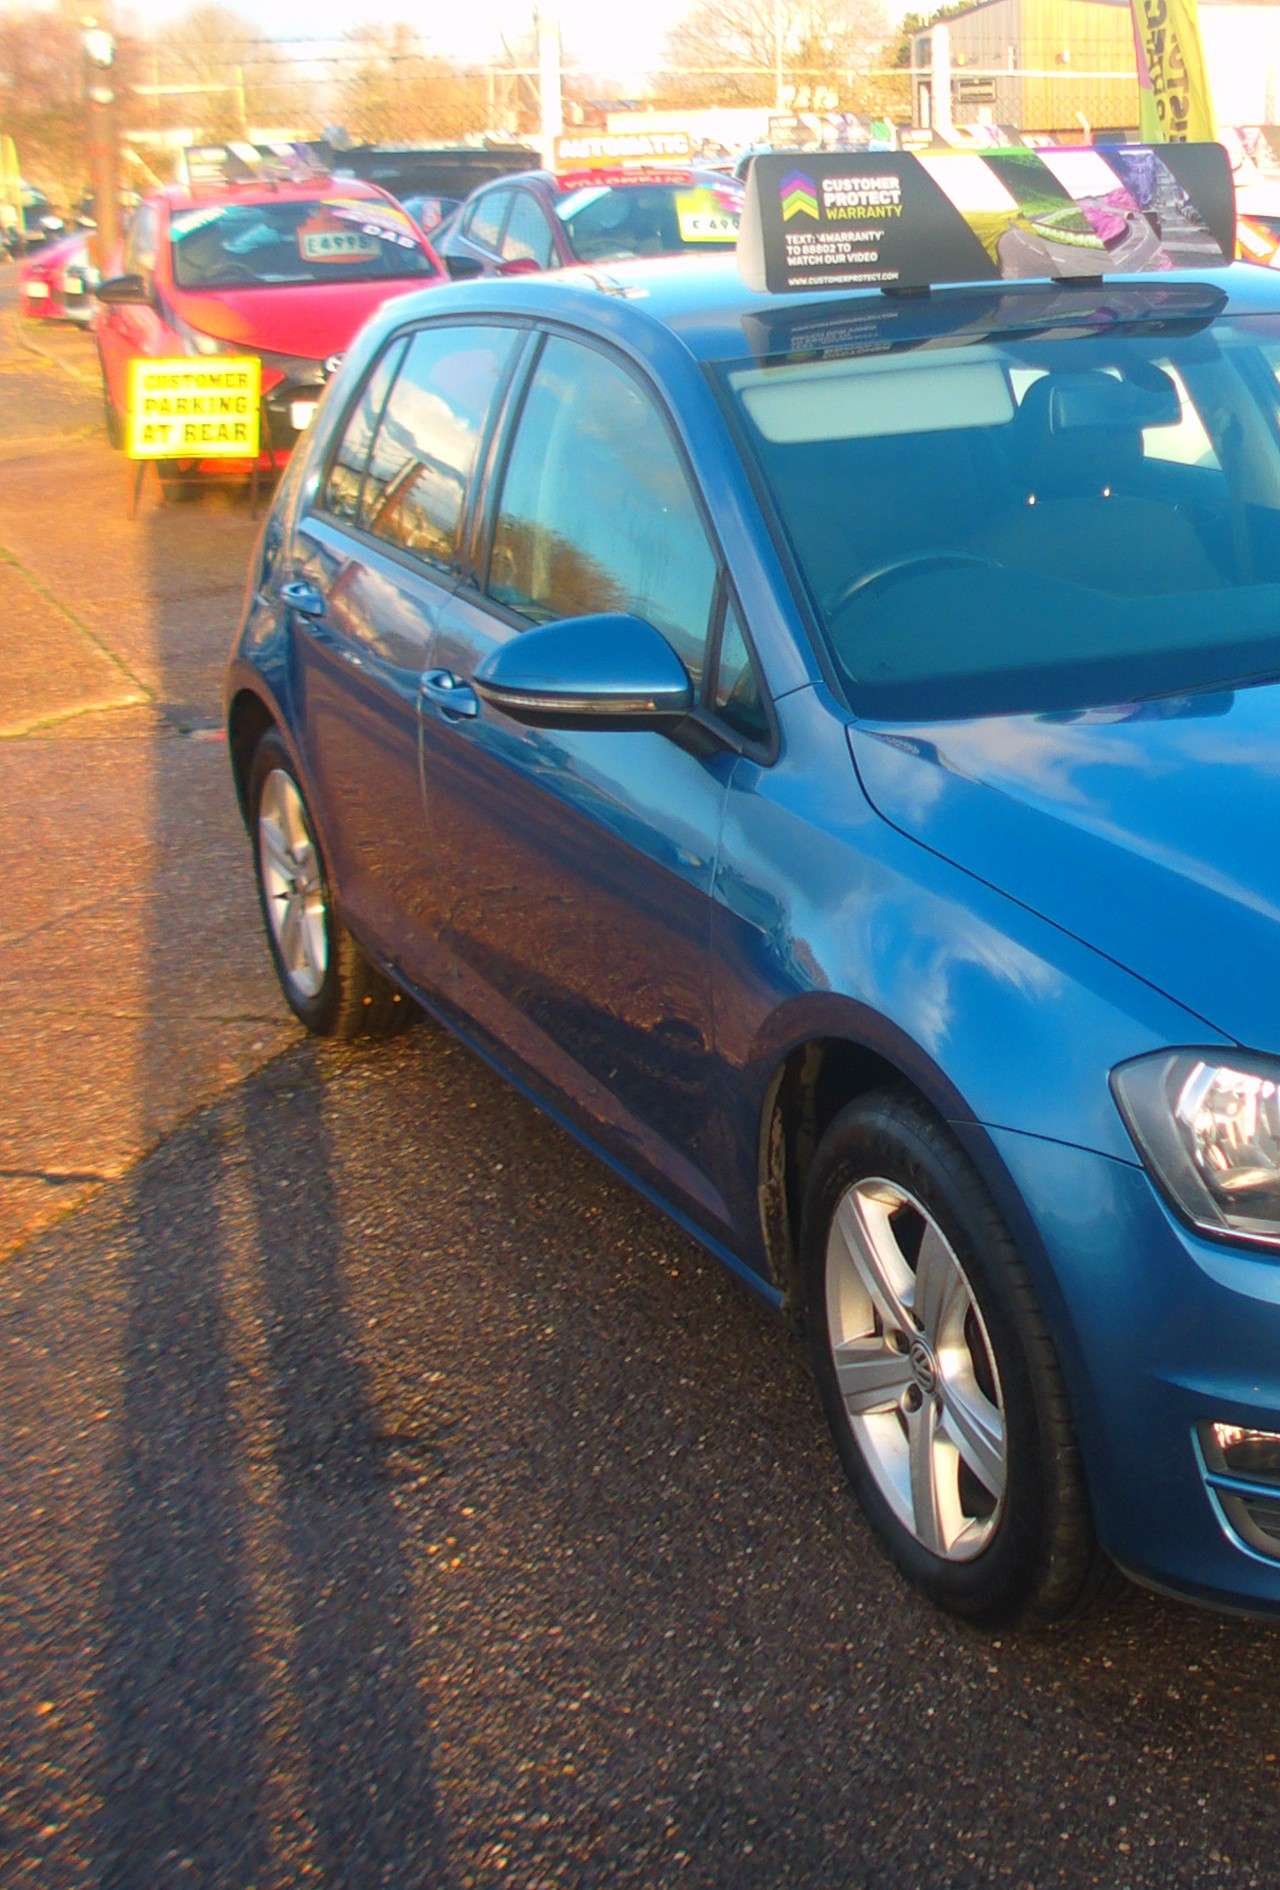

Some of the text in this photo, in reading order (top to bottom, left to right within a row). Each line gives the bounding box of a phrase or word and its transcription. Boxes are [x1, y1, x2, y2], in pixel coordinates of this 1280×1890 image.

[822, 177, 900, 191] CUSTOMER
[823, 190, 901, 207] PROTECT
[826, 205, 903, 220] WARRANTY
[363, 223, 417, 248] DAB
[785, 234, 816, 245] TEXT:
[786, 245, 801, 255] TO
[837, 243, 852, 253] TO
[787, 252, 878, 266] WATCH OUR VIDEO
[144, 396, 248, 414] PARKING
[144, 423, 248, 442] AT REAR
